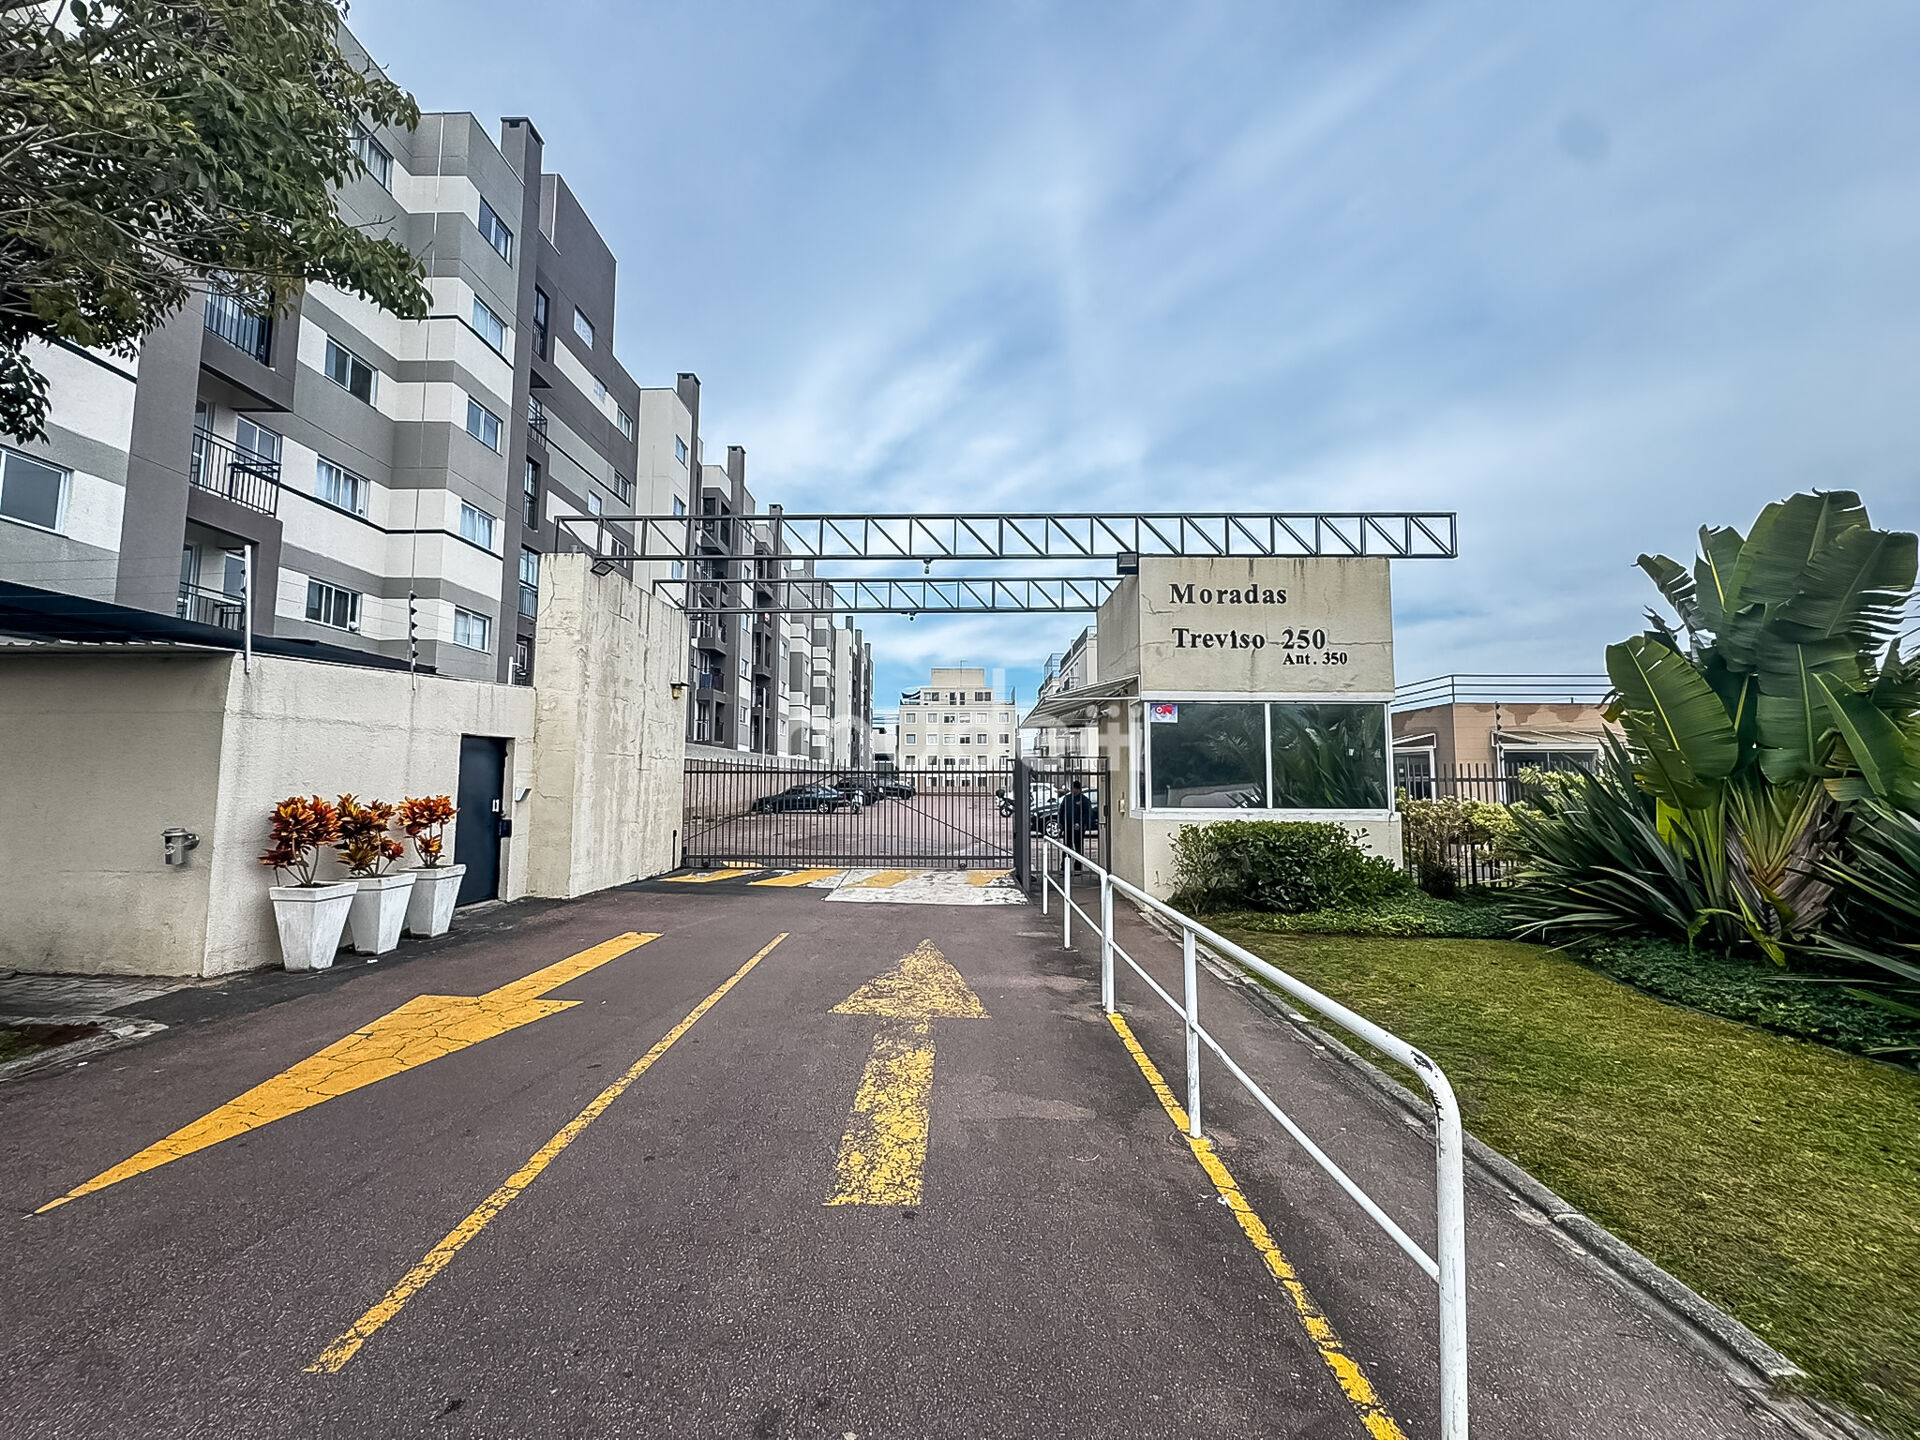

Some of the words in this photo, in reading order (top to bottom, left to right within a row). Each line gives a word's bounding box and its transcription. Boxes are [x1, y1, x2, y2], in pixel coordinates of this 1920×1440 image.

[1169, 583, 1287, 604] Moradas
[1171, 628, 1265, 649] Treviso
[1281, 628, 1326, 649] 250
[1282, 652, 1317, 665] Ant.
[1322, 652, 1348, 665] 350
